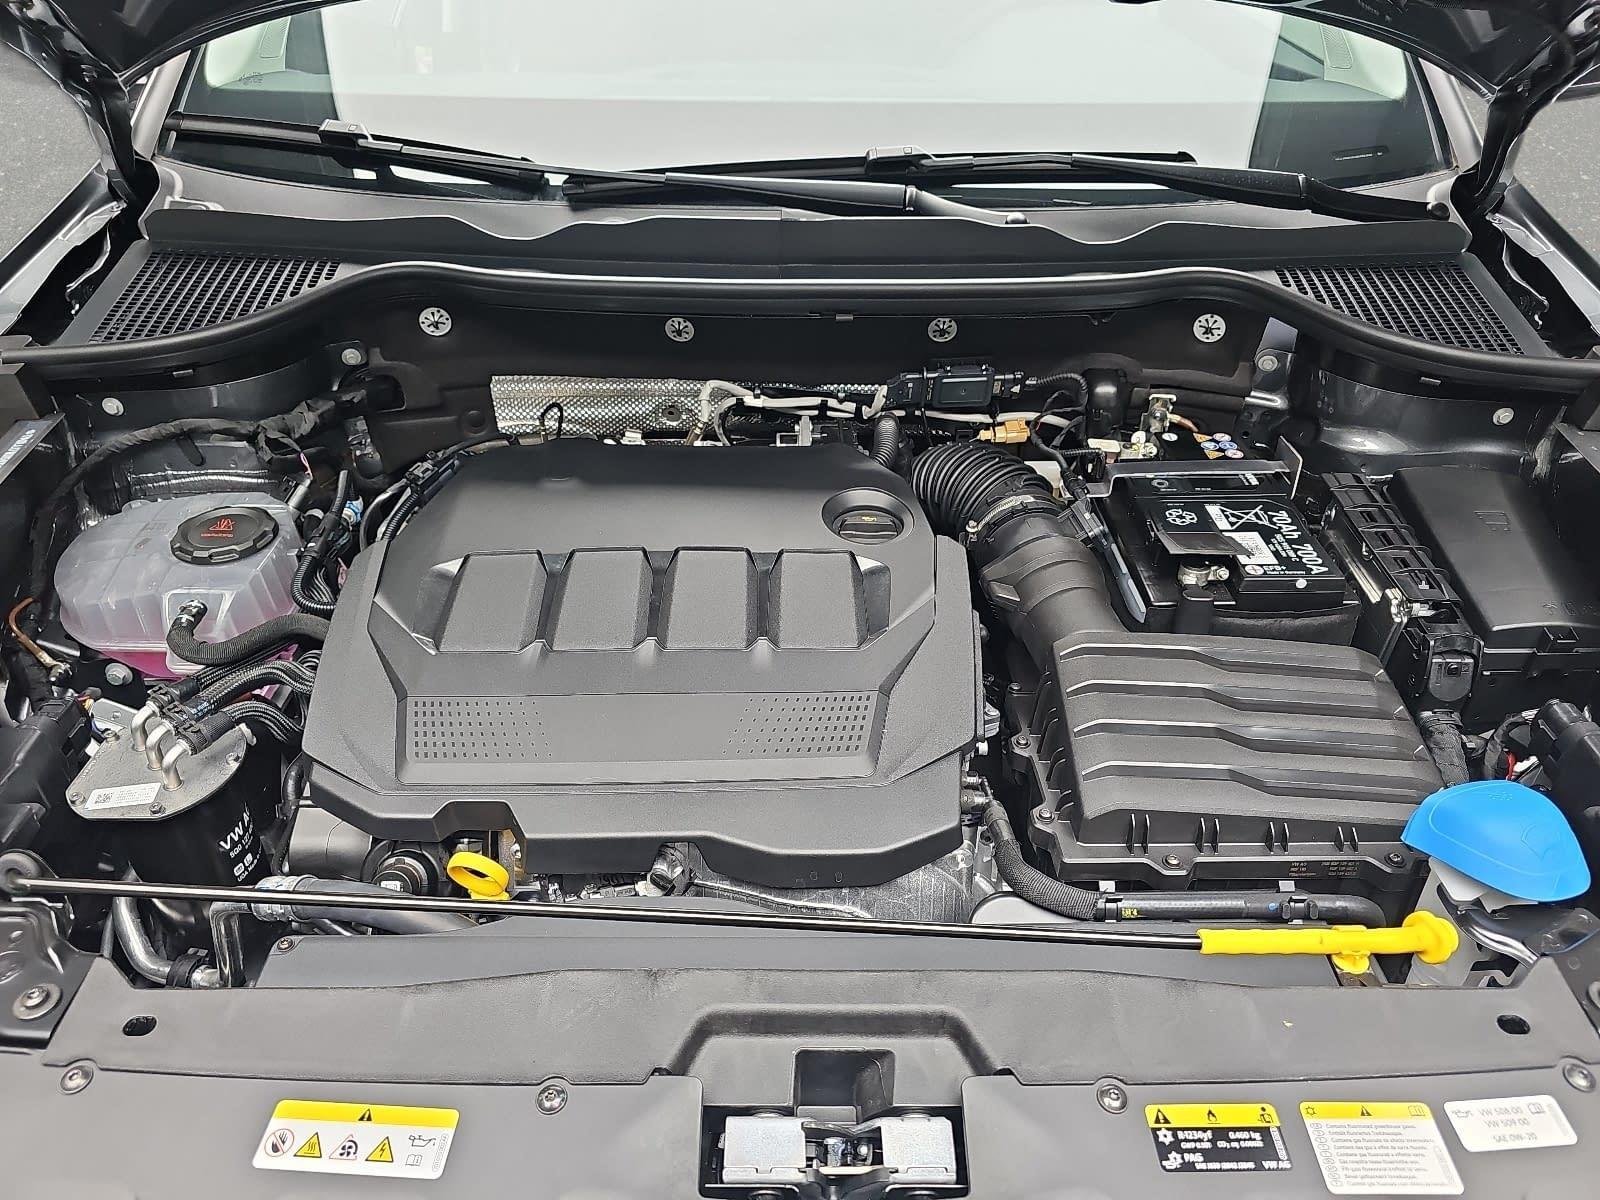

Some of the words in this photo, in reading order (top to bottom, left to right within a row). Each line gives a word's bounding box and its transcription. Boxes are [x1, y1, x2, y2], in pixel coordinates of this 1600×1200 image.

[1267, 510, 1302, 539] 70Ah
[1291, 543, 1329, 574] 700A
[219, 821, 244, 850] VW
[1478, 1109, 1493, 1117] VW
[1484, 1120, 1499, 1128] VW
